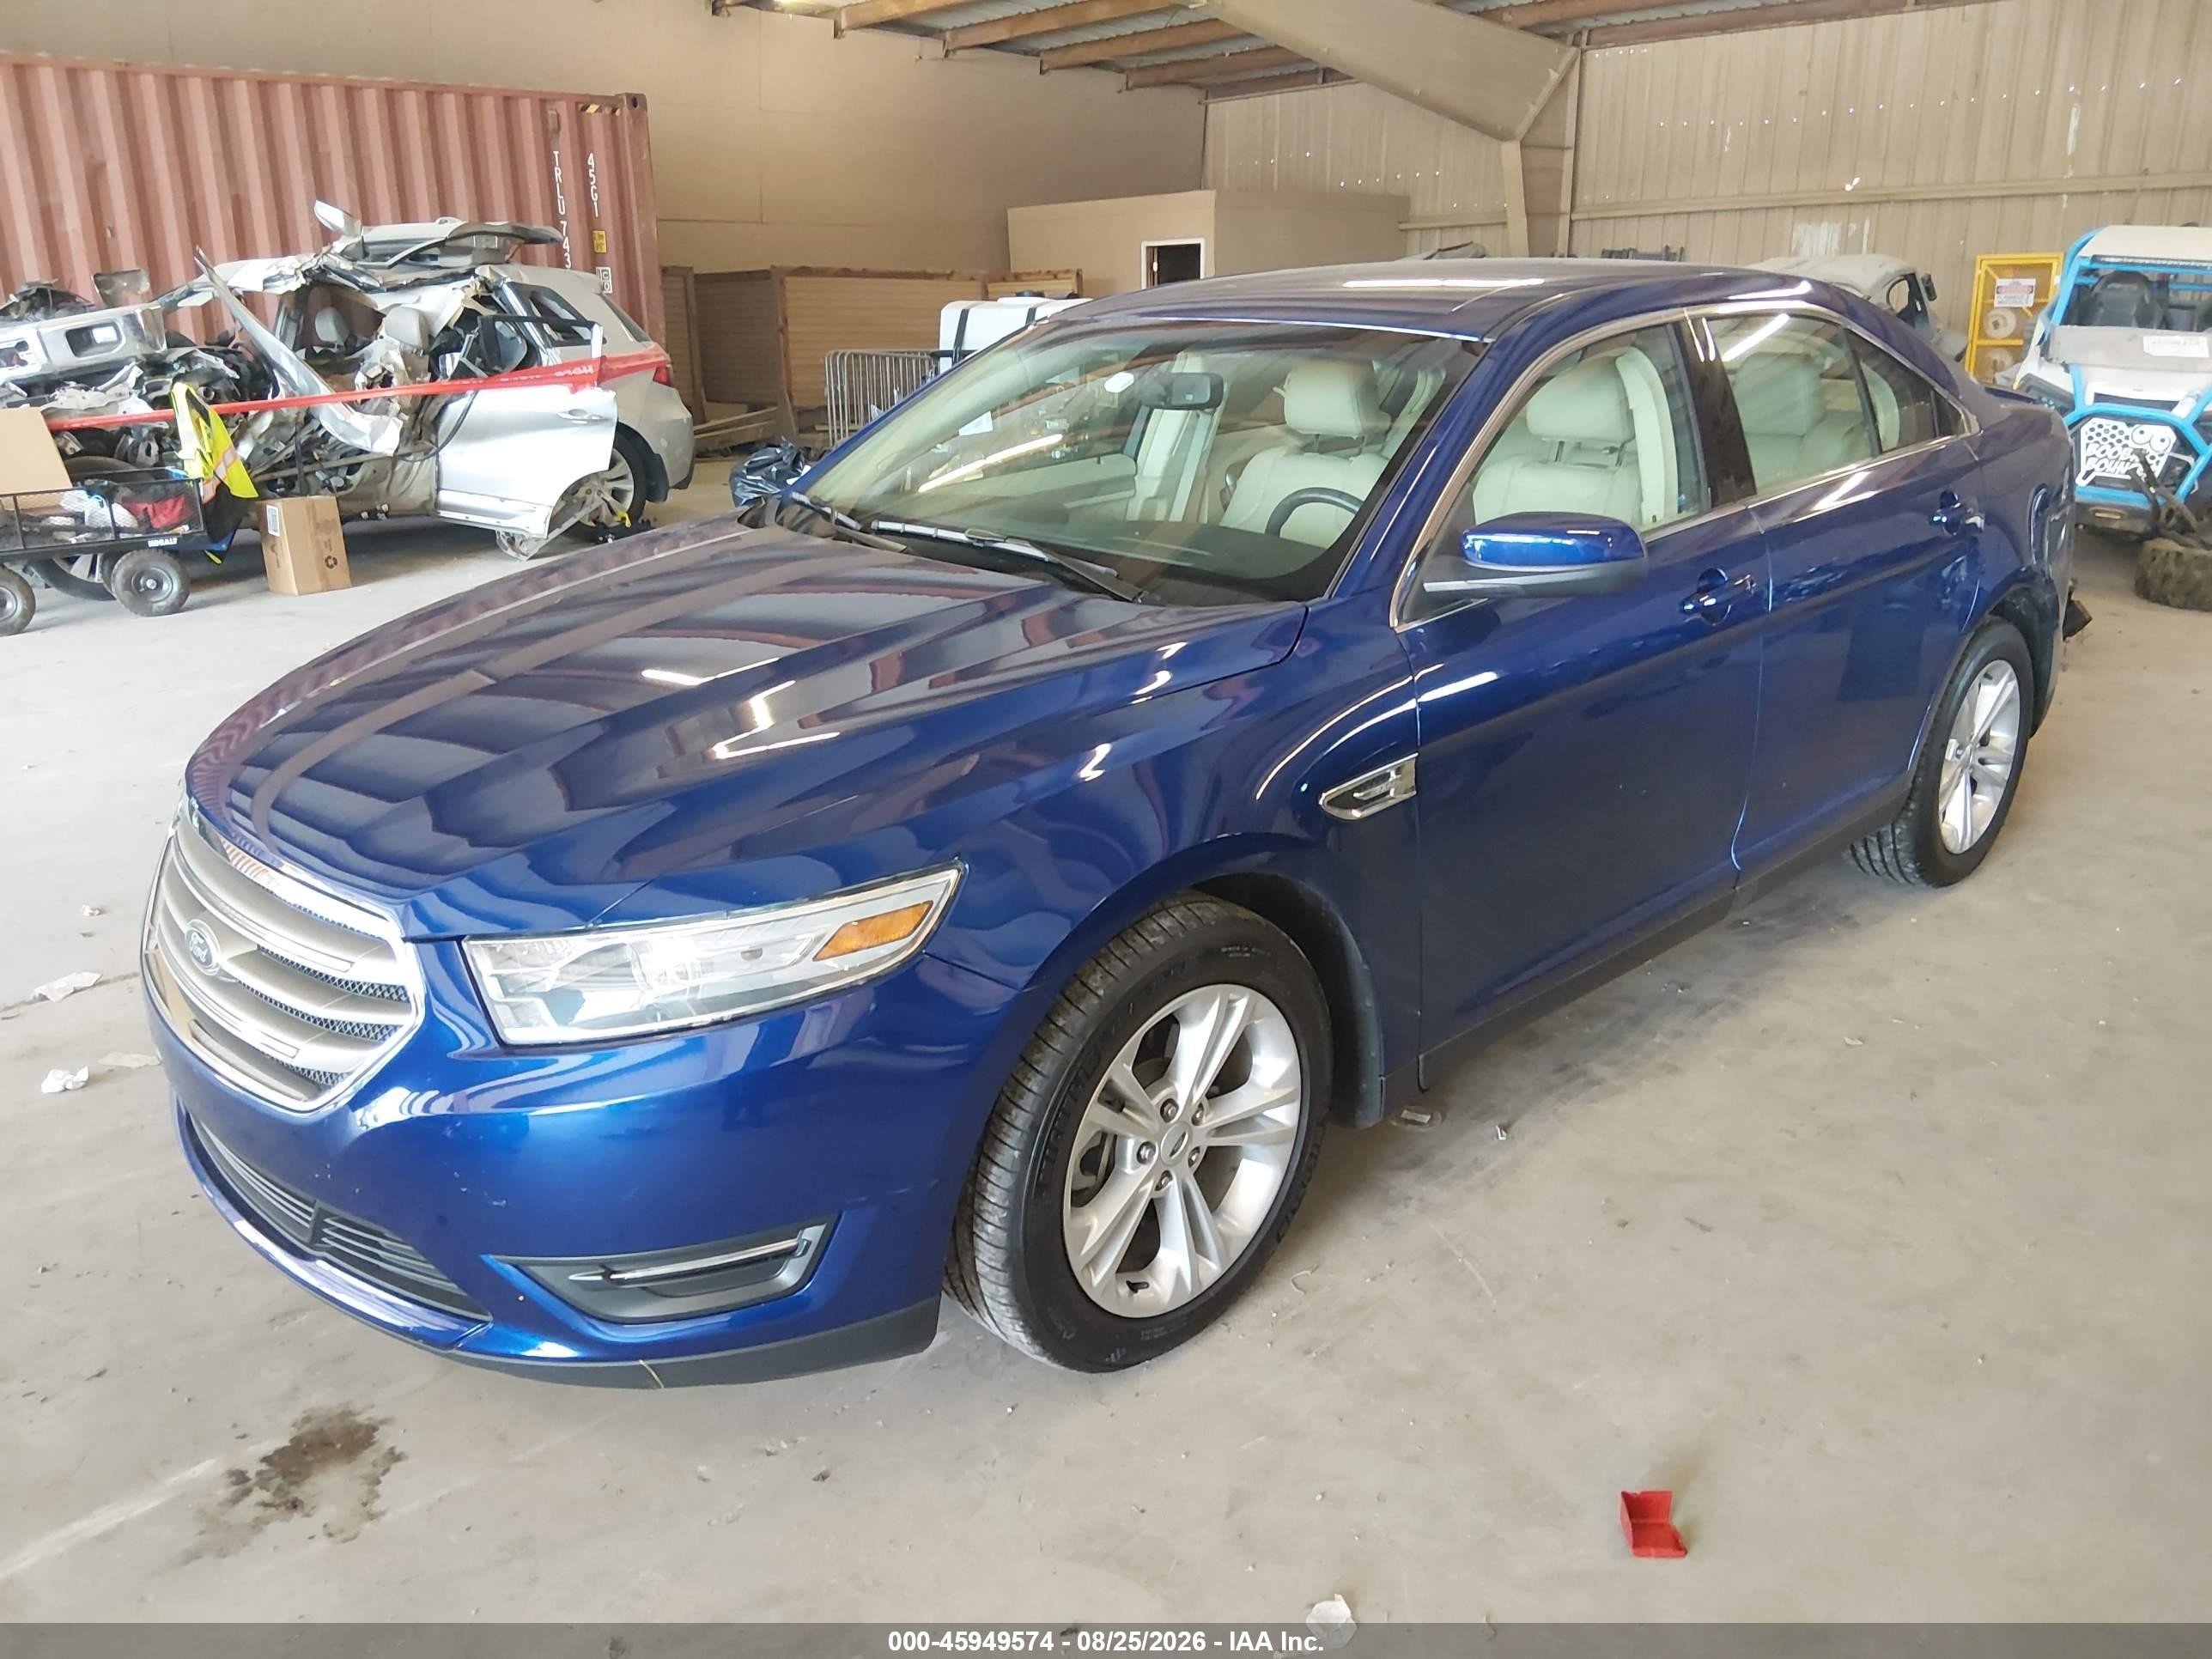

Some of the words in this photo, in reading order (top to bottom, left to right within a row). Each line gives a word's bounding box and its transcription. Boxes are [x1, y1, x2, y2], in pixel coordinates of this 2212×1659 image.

[553, 150, 566, 215] TRLU
[587, 153, 599, 217] 45G1
[189, 932, 208, 963] Ford
